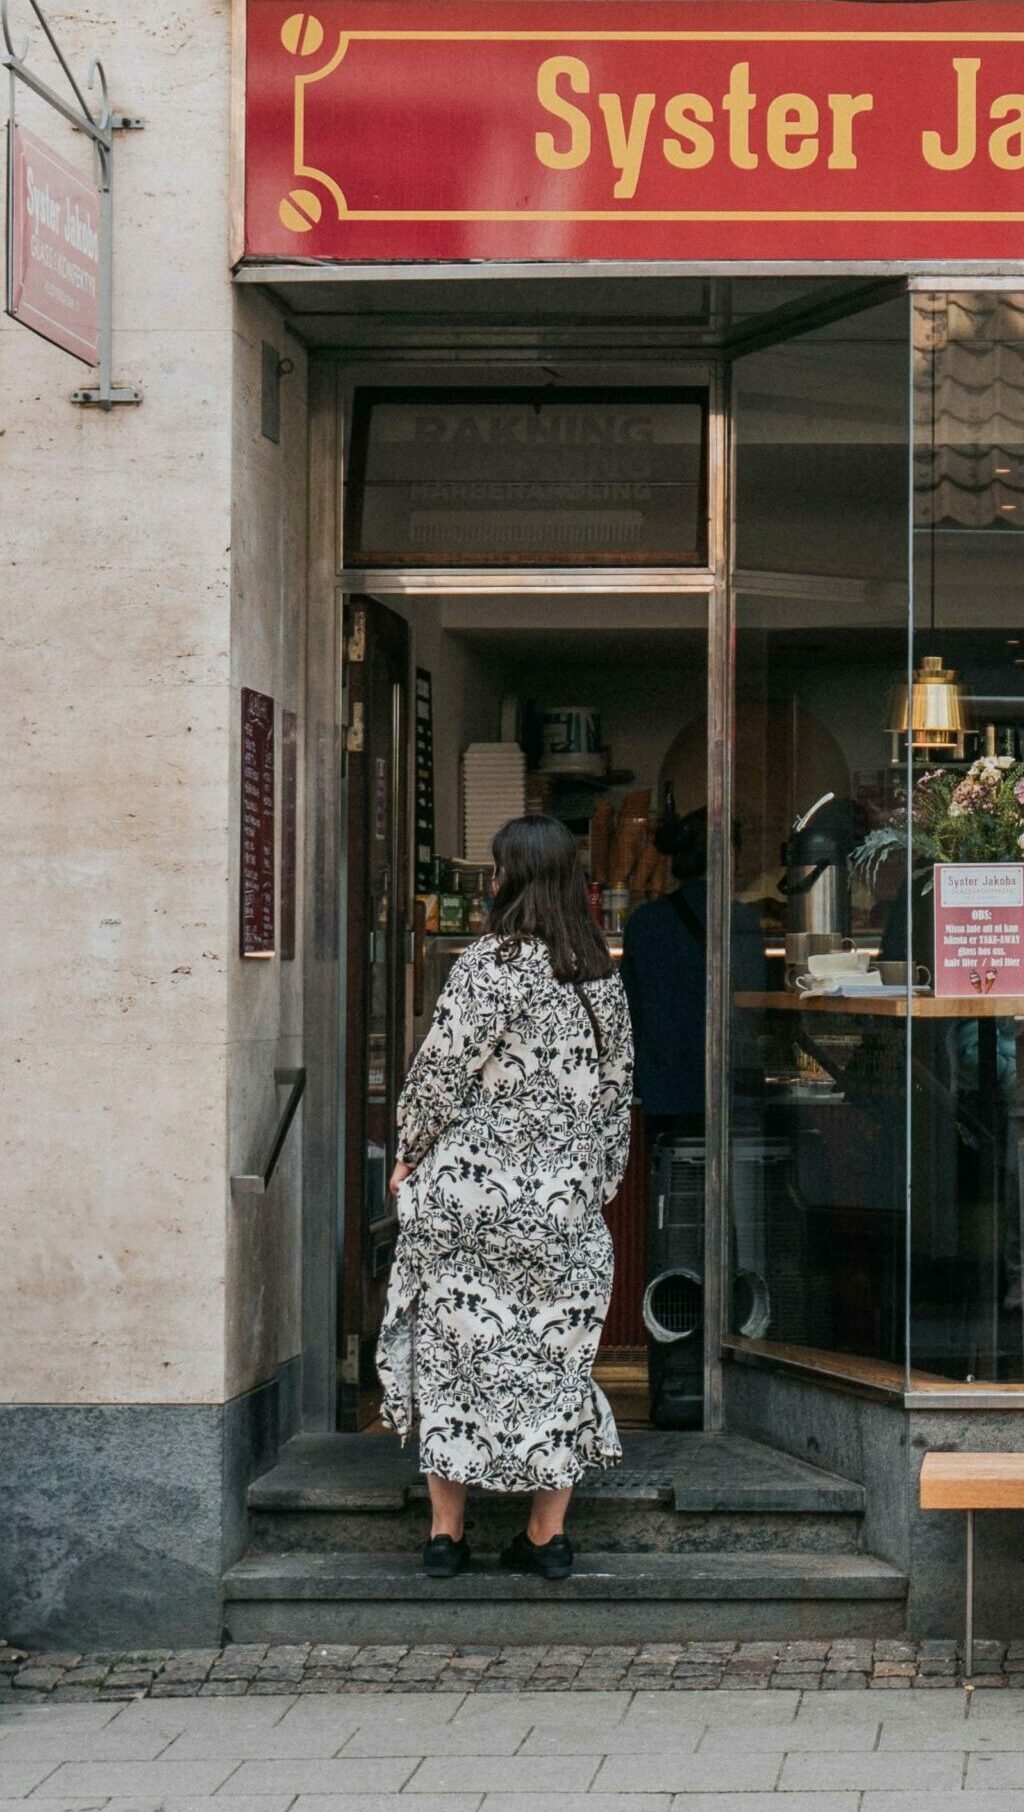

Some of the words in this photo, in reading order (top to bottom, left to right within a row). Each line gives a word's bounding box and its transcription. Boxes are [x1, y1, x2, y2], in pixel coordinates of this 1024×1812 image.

[534, 55, 874, 199] Syster
[26, 165, 61, 235] Syster
[64, 196, 99, 263] Jakobs
[948, 875, 977, 888] Syster
[982, 875, 1016, 886] Jakobs
